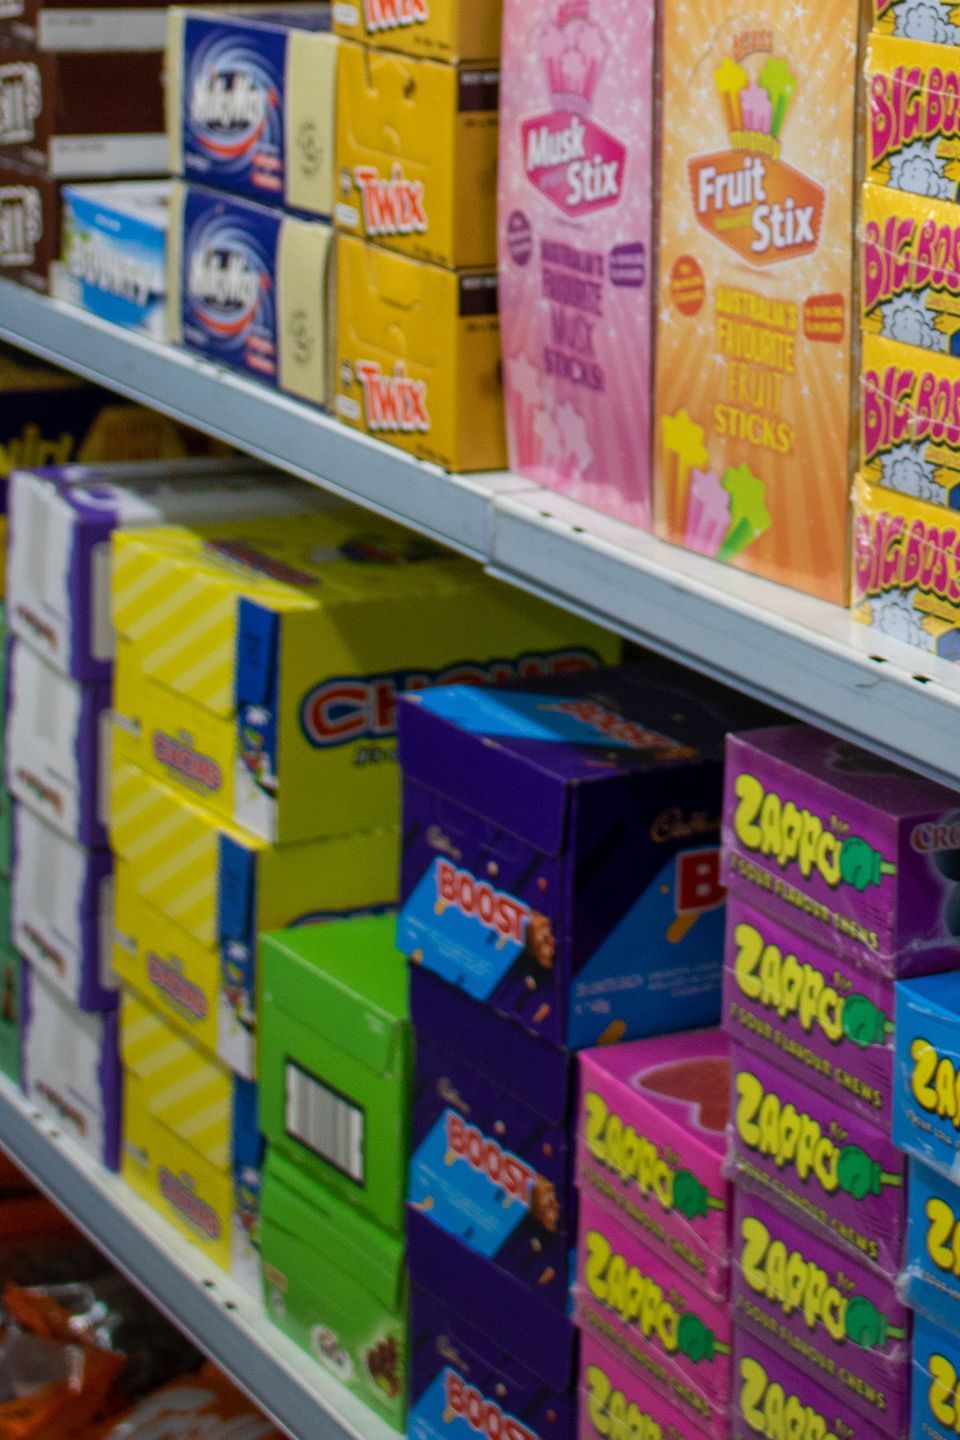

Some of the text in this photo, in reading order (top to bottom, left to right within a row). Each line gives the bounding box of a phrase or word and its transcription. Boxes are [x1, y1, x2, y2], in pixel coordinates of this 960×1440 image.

[871, 66, 922, 162] BIG
[527, 118, 586, 172] Musk
[566, 158, 619, 207] Stix
[698, 157, 767, 214] Fruit
[750, 197, 815, 253] Stix
[713, 403, 792, 454] STICKS
[435, 859, 527, 944] BOOST
[444, 1111, 535, 1205] BOOST
